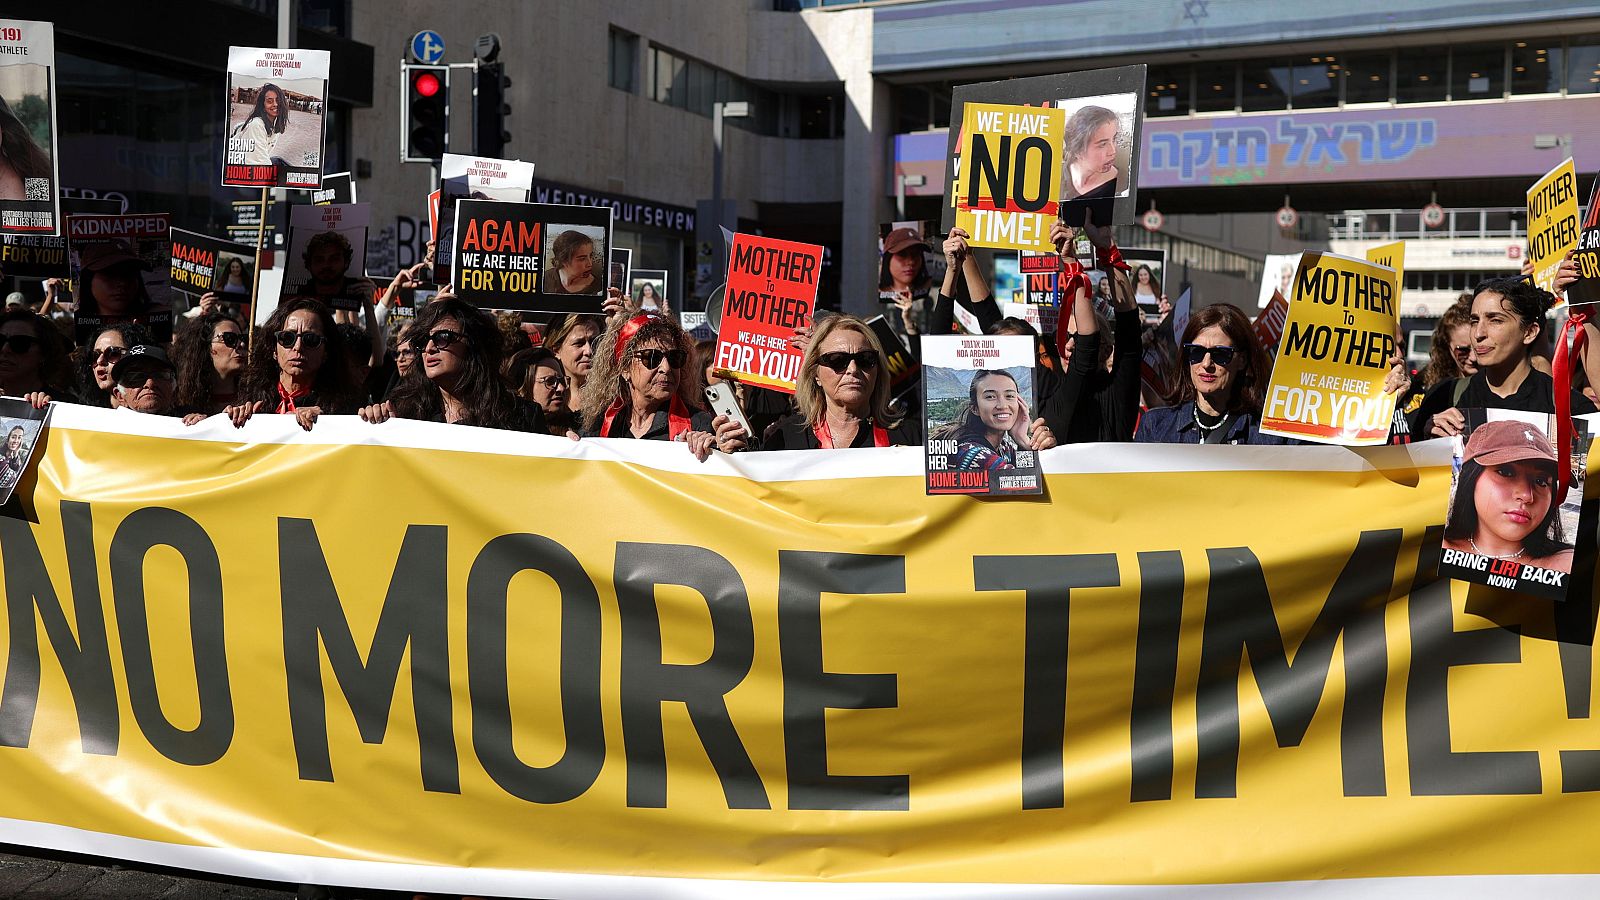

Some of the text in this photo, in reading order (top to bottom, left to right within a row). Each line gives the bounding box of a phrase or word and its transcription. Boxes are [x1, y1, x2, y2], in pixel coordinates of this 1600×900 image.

[272, 68, 284, 77] (24)
[977, 110, 1050, 136] WE HAVE
[228, 138, 255, 152] BRING
[1150, 118, 1437, 181] ישראל חזקה
[227, 152, 246, 165] HER
[226, 166, 251, 179] HOME
[253, 165, 278, 180] NOW!
[480, 177, 491, 186] (24)
[967, 133, 1053, 212] NO
[1528, 171, 1574, 226] MOTHER
[2, 217, 53, 228] FAMILIES FORUM
[71, 217, 168, 235] KIDNAPPED
[970, 209, 1043, 246] TIME!
[1545, 214, 1552, 227] To
[3, 234, 65, 248] WE ARE HERE
[462, 218, 541, 255] AGAM
[1528, 214, 1578, 263] MOTHER
[2, 245, 64, 265] FOR YOU!
[172, 241, 214, 267] NAAMA
[439, 240, 452, 253] BRI
[171, 257, 213, 277] WE ARE HERE
[462, 252, 539, 271] WE ARE HERE
[733, 243, 816, 285] MOTHER
[1022, 255, 1059, 268] HOME NOW!
[170, 266, 211, 290] FOR YOU!
[461, 269, 537, 294] FOR YOU!
[766, 279, 775, 292] To
[1030, 292, 1043, 303] WE
[1296, 265, 1394, 317] MOTHER
[397, 306, 414, 317] HERE
[726, 287, 809, 329] MOTHER
[1343, 310, 1355, 326] To
[738, 330, 788, 351] WE ARE HERE
[1284, 321, 1395, 370] MOTHER
[717, 341, 801, 384] FOR YOU!
[956, 349, 1000, 358] NOA ARGAMANI
[972, 358, 985, 368] (26)
[1300, 371, 1371, 396] WE ARE HERE
[1268, 384, 1322, 426] FOR
[1329, 392, 1391, 431] YOU!
[928, 439, 958, 455] BRING
[928, 455, 948, 470] HER
[929, 469, 989, 488] HOME NOW!
[999, 479, 1037, 489] FAMILIES FORUM
[1442, 548, 1566, 588] BRING LIRI BACK
[1486, 574, 1517, 590] NOW!
[0, 500, 1600, 812] NO MORE TIME!
